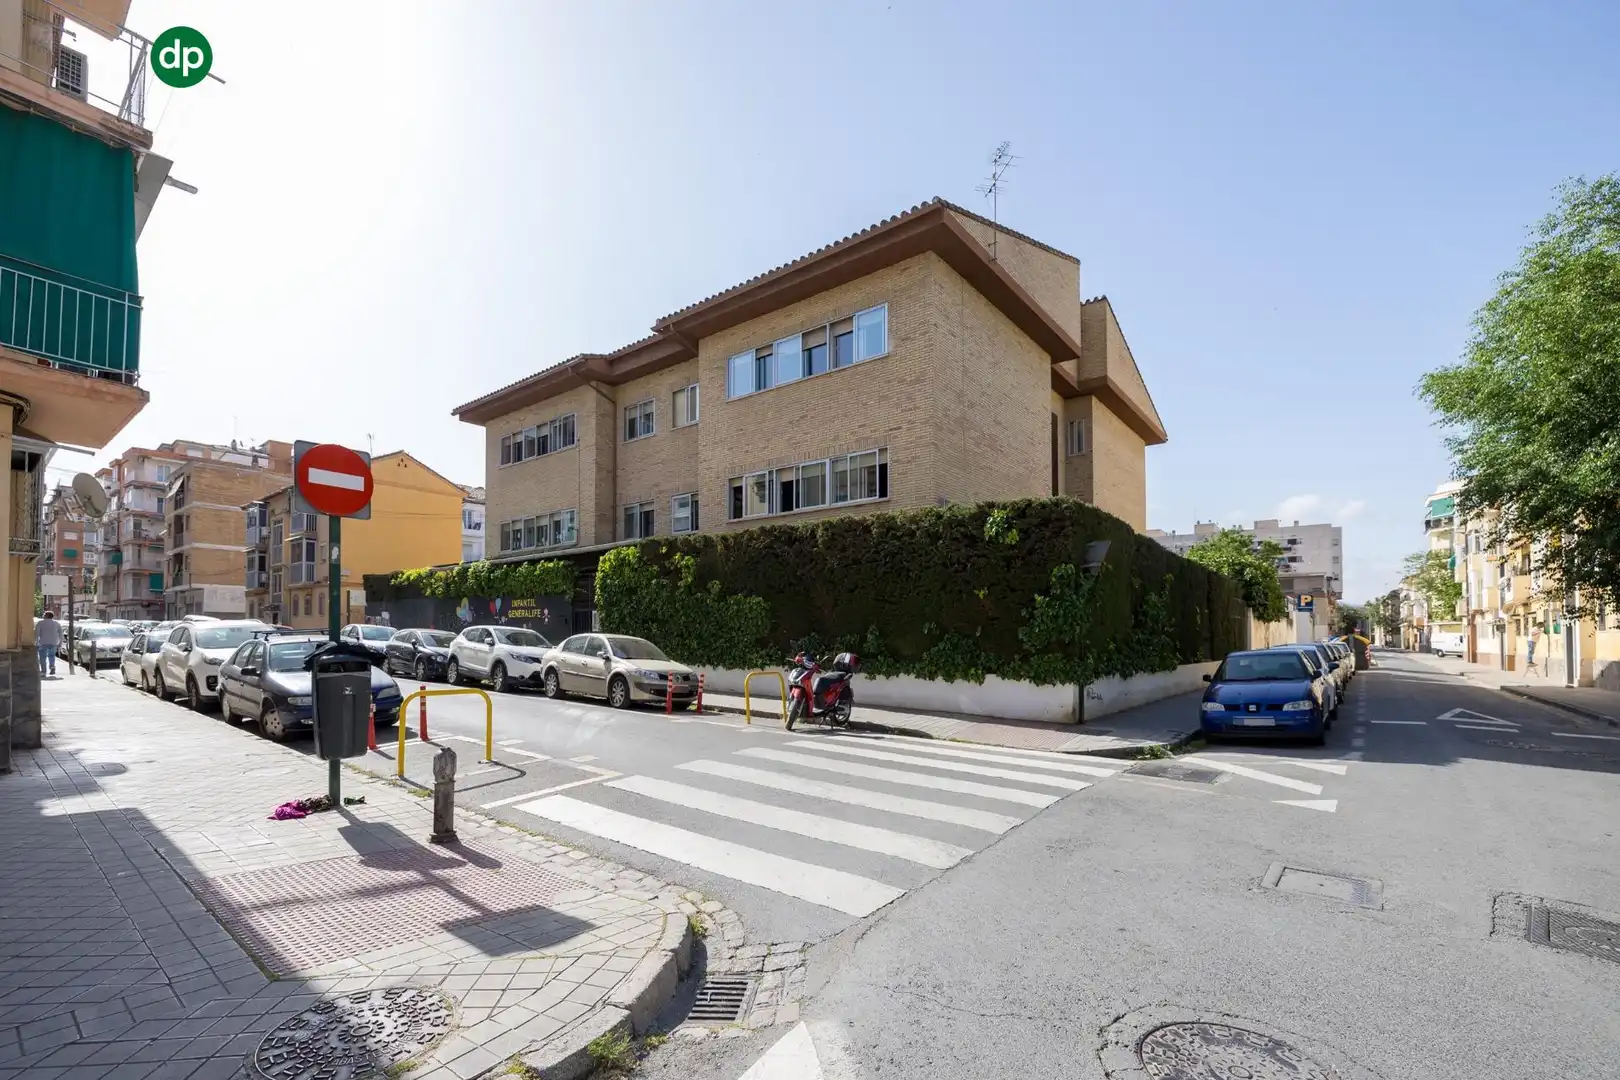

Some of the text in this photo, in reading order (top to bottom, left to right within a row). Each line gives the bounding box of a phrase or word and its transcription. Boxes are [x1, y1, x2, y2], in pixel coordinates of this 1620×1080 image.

[511, 599, 536, 607] INFANTIL
[1300, 595, 1312, 606] P
[507, 609, 542, 618] GENERALIFE
